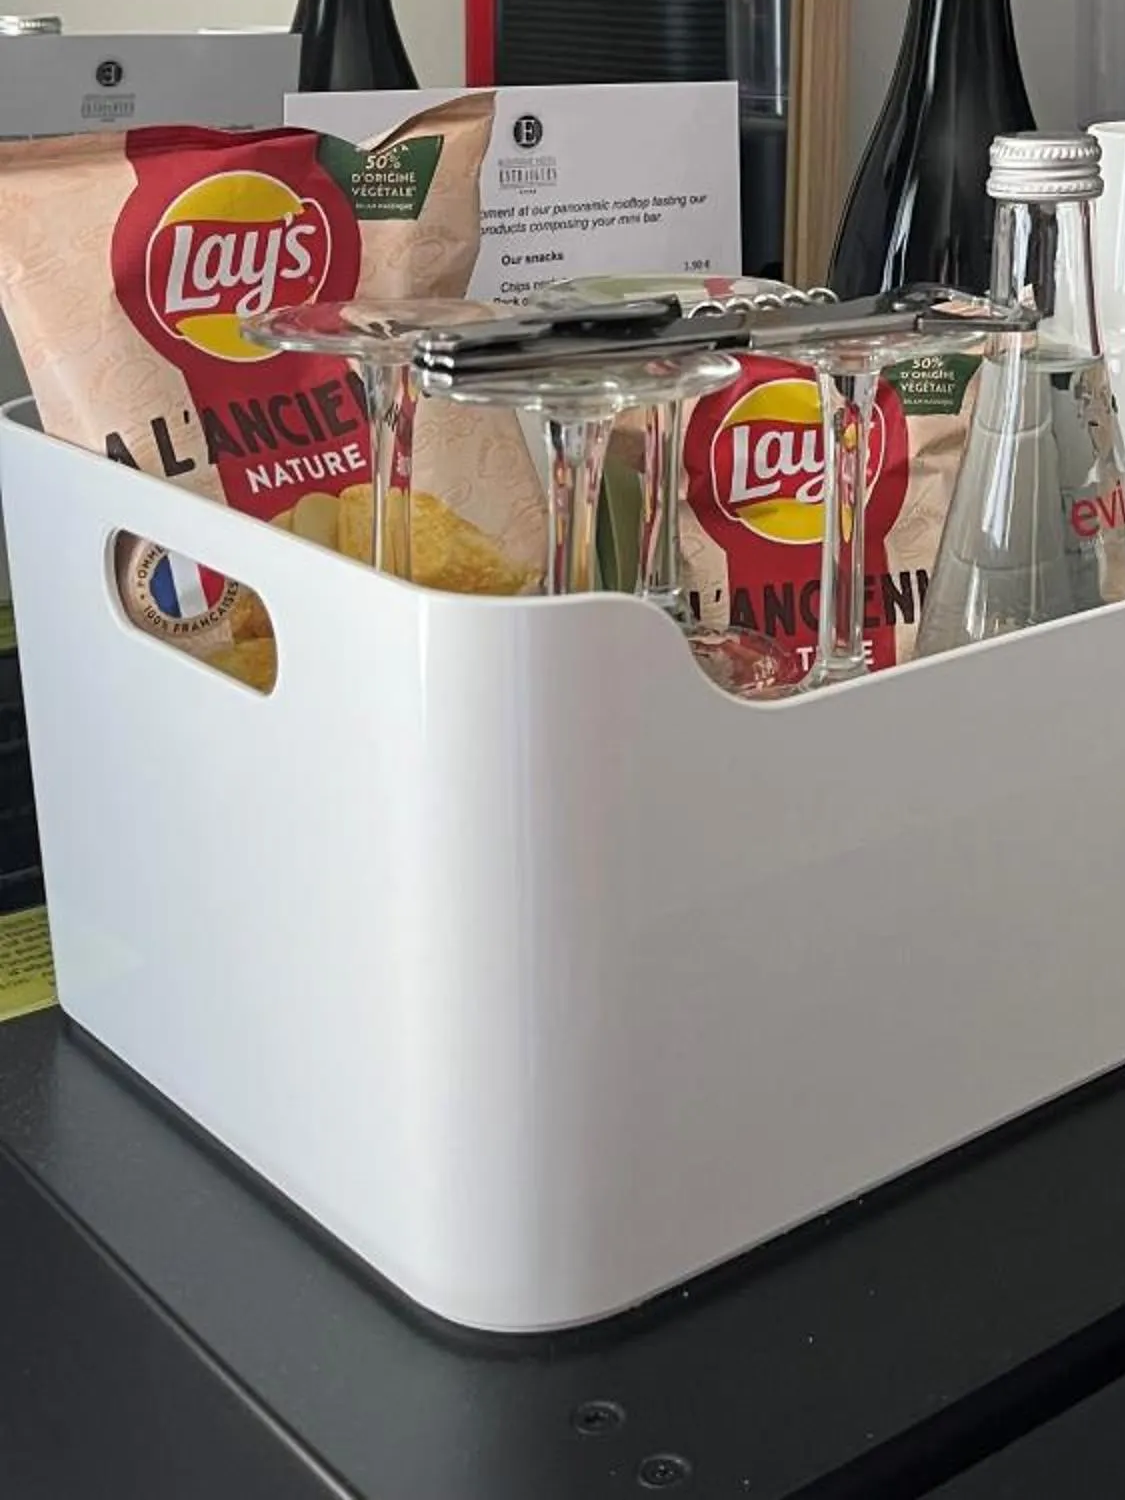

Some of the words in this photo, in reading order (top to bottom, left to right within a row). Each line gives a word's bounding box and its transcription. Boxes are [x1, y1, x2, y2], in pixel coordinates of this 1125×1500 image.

[365, 154, 402, 170] 50%
[351, 172, 417, 184] D'ORIGINE
[532, 206, 552, 216] our
[552, 202, 610, 217] panoramic
[612, 197, 650, 211] rooftop
[651, 195, 688, 209] tasting
[689, 195, 708, 205] our
[529, 219, 590, 235] composing
[591, 217, 617, 231] your
[165, 211, 316, 318] Lay's
[501, 255, 522, 267] Our
[525, 251, 565, 264] snacks
[501, 281, 531, 294] Chips
[245, 444, 367, 494] NATURE
[143, 605, 169, 631] 100%
